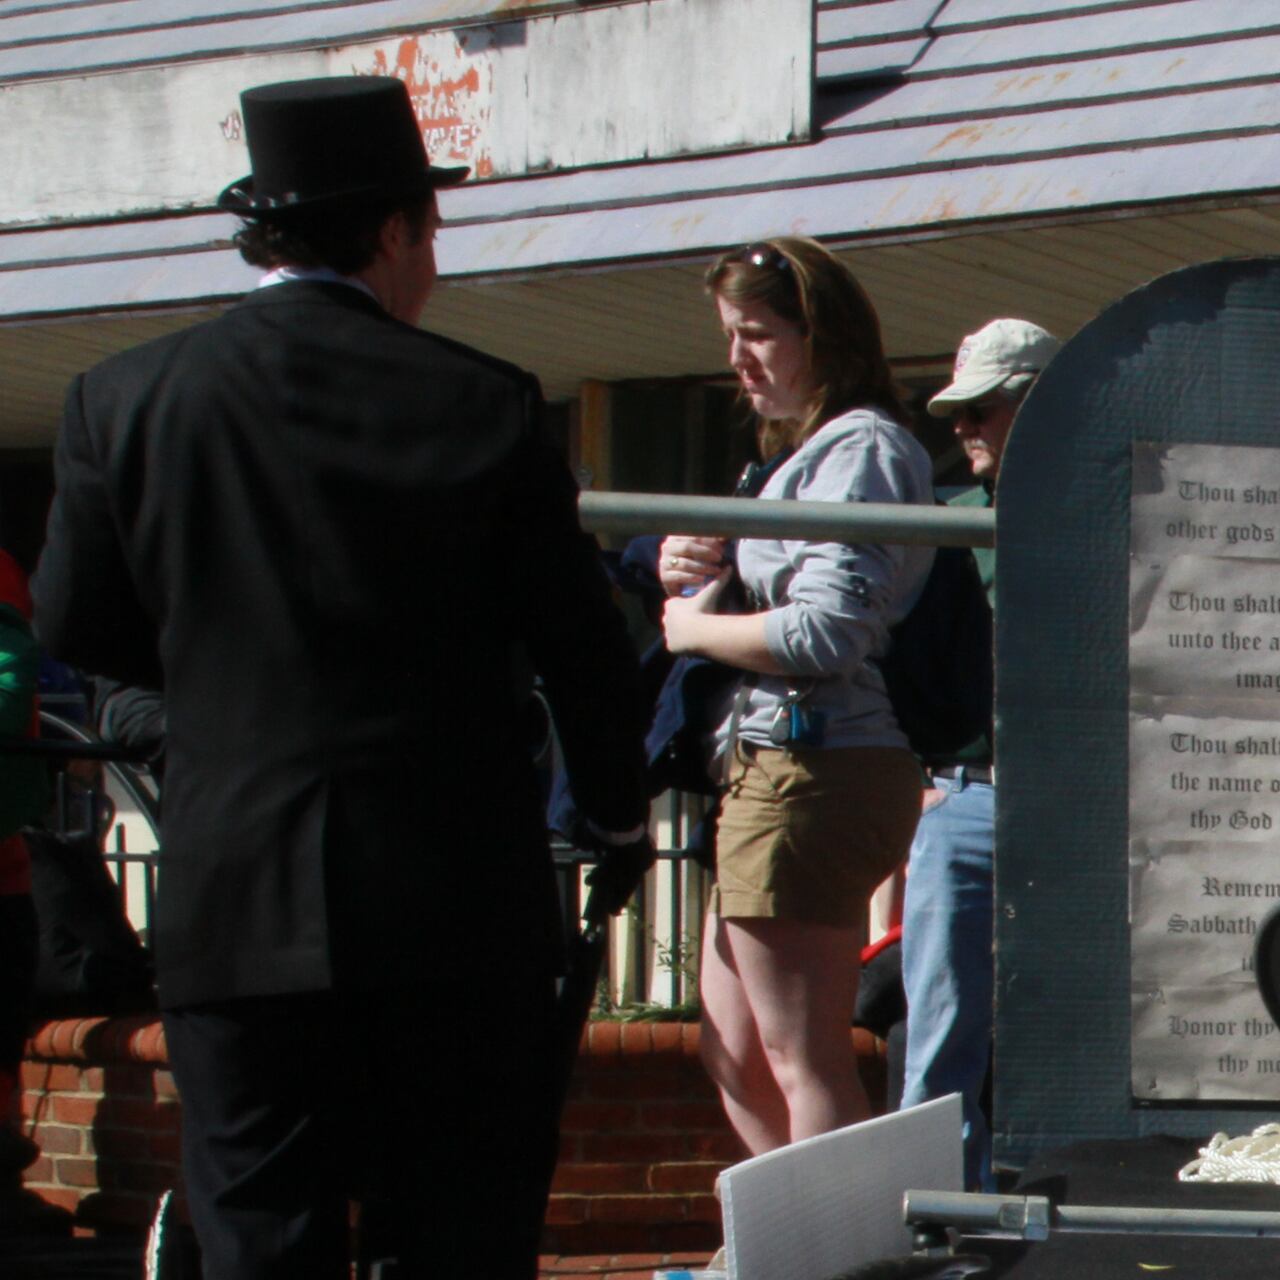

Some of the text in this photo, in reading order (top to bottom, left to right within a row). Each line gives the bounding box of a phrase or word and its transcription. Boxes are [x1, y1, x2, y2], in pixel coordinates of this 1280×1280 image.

[1178, 480, 1235, 505] Thou
[1166, 519, 1218, 542] other
[1226, 523, 1275, 544] gods
[1168, 591, 1225, 615] Thou
[1168, 632, 1214, 650] unto
[1222, 631, 1262, 651] thee
[1170, 732, 1227, 755] Thou
[1171, 772, 1200, 792] the
[1208, 777, 1263, 794] name
[1190, 809, 1222, 831] thy
[1229, 810, 1273, 831] God
[1167, 914, 1257, 936] Sabbath
[1168, 1015, 1238, 1037] Honor
[1219, 1054, 1250, 1077] thy
